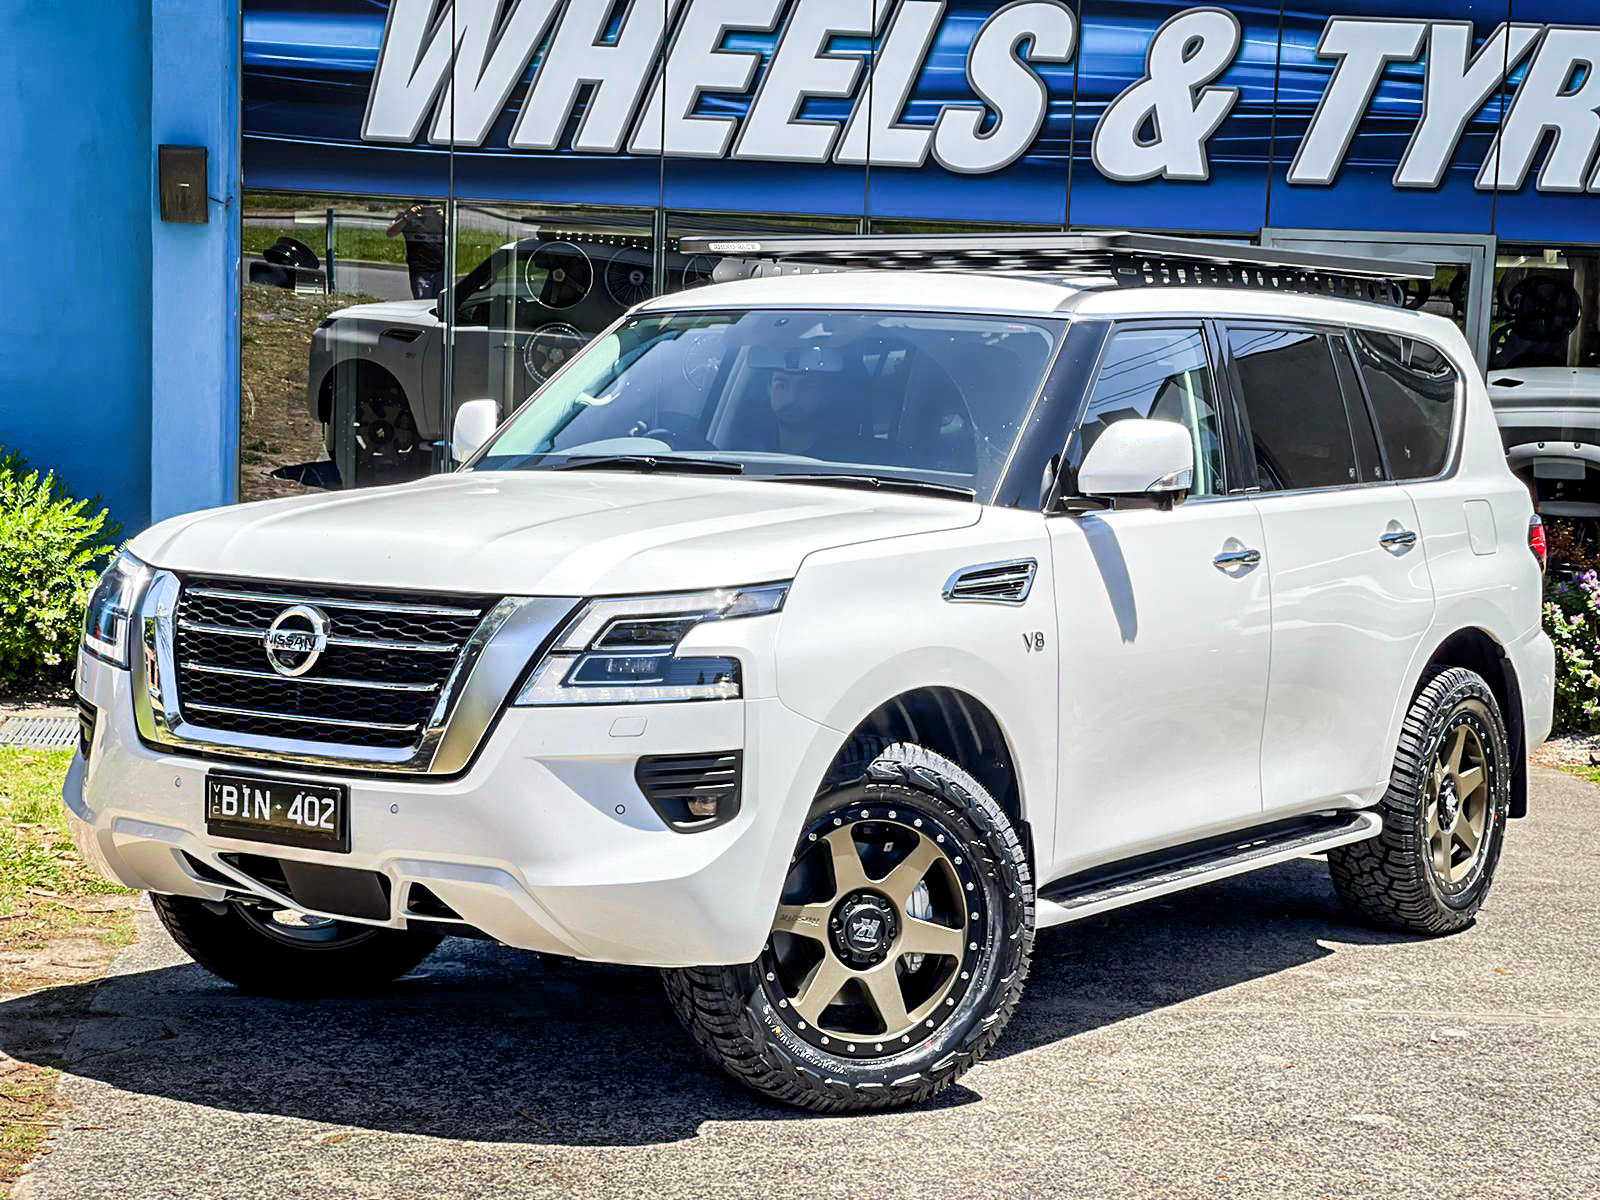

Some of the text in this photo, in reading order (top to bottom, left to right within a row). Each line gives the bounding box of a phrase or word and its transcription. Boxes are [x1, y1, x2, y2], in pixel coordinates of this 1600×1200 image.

[358, 0, 1600, 193] WHEELS & TYR
[265, 630, 317, 650] NISSAN
[1022, 631, 1045, 653] V8
[213, 783, 221, 815] VIC
[221, 785, 336, 830] BIN 402
